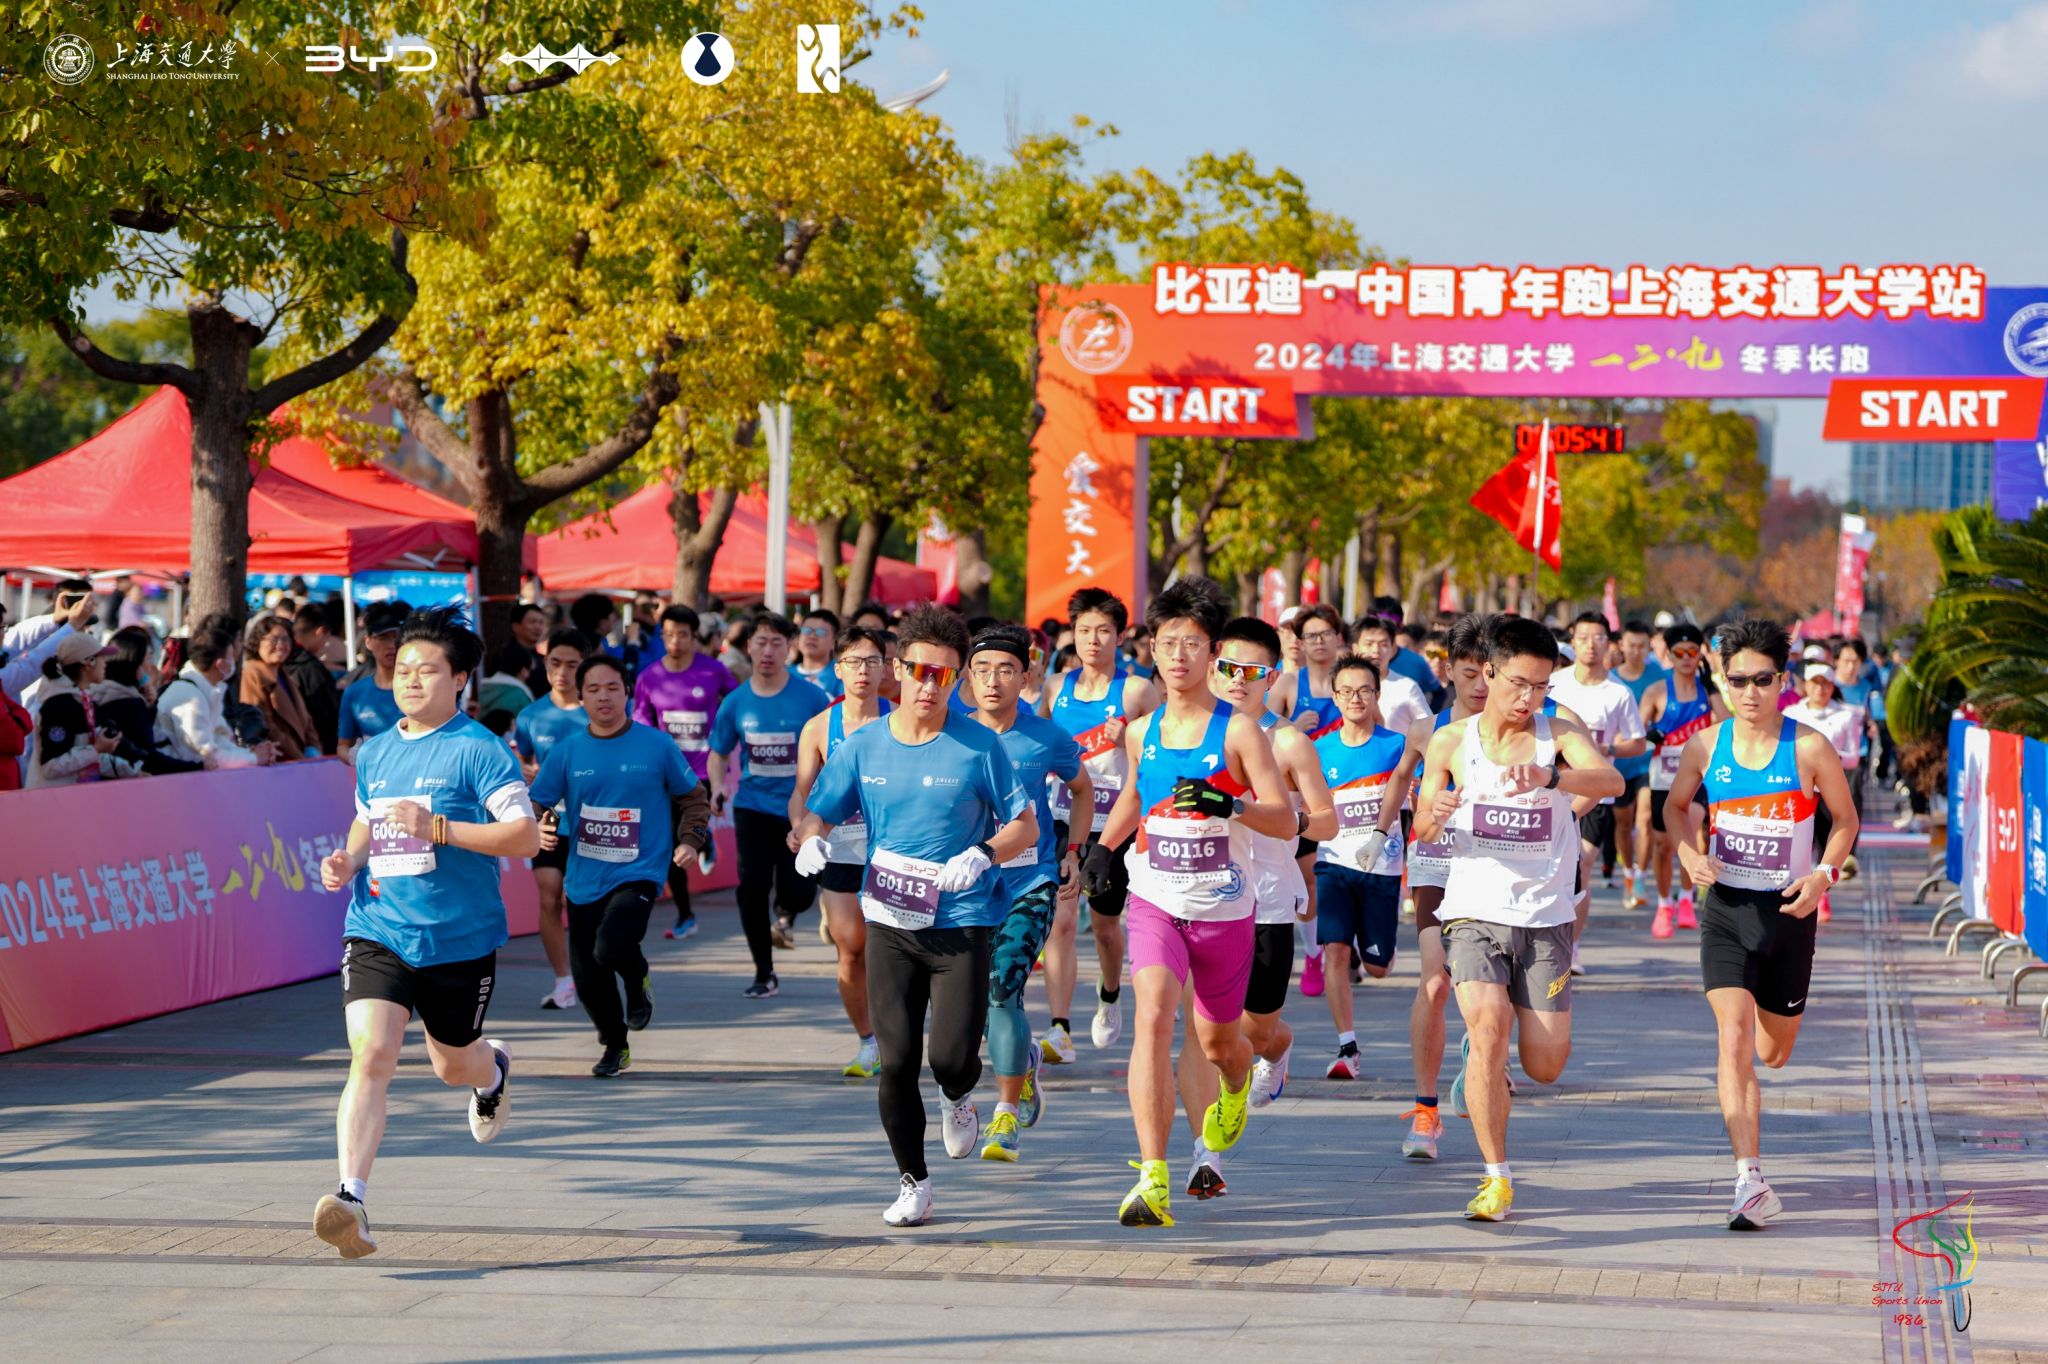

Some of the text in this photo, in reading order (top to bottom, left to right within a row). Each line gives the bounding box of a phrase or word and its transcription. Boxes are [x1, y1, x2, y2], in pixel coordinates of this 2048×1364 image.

[1154, 266, 1983, 318] 比亚迪·中国青年跑上海交通大学站
[1254, 343, 1575, 373] 2024年上海交通大学
[1739, 344, 1870, 373] 冬季长跑
[1127, 386, 1265, 423] START
[1860, 390, 2007, 427] START
[752, 747, 788, 757] G0066
[573, 769, 595, 777] BYD
[861, 775, 887, 785] BYD
[1343, 801, 1384, 818] G013
[1517, 796, 1550, 806] BYD
[1485, 809, 1542, 829] G0212
[585, 822, 629, 838] G0203
[1185, 825, 1224, 835] BYD
[1752, 824, 1789, 834] BYD
[1157, 840, 1216, 859] G0116
[1724, 834, 1779, 856] G0172
[903, 862, 939, 877] BYD
[876, 871, 927, 898] G0113
